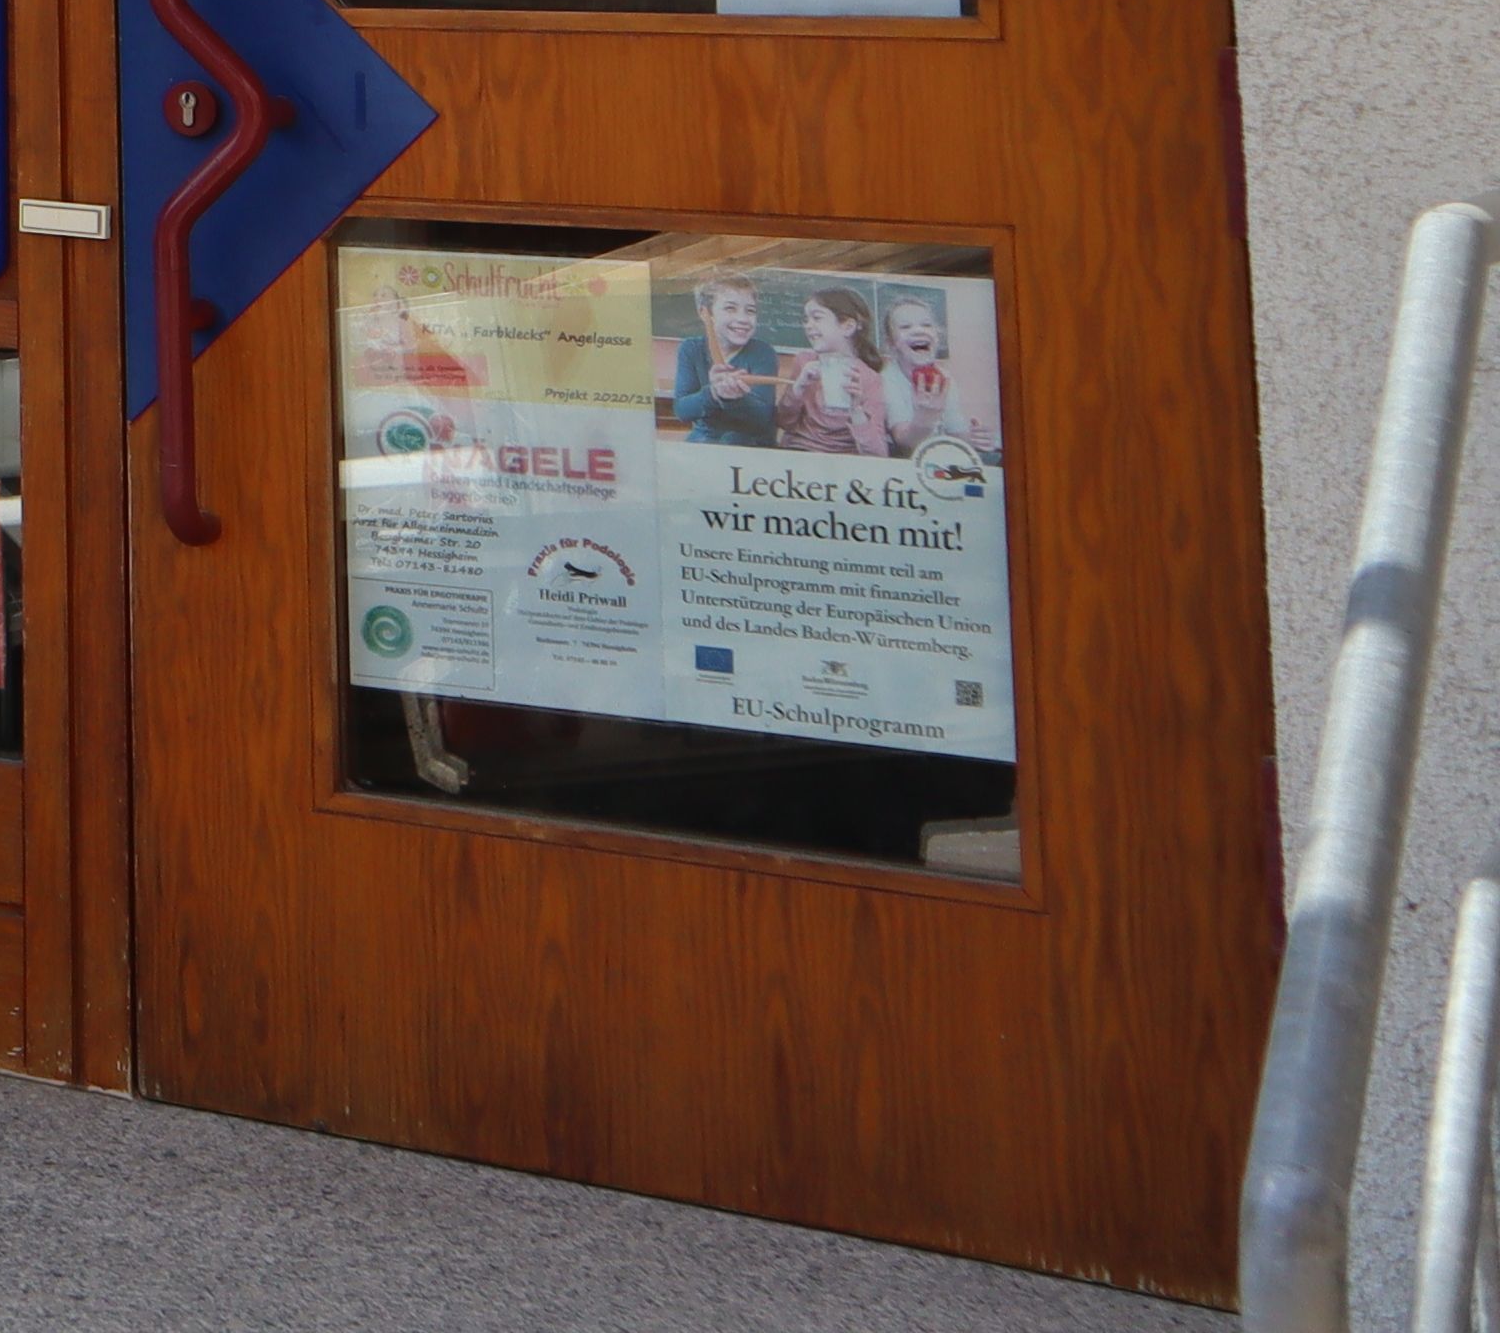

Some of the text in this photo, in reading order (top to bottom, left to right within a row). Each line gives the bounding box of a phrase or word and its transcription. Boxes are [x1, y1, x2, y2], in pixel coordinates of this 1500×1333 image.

[443, 261, 561, 300] Schulfrucht
[422, 323, 632, 348] KITA Angelgasse
[545, 388, 588, 402] Projekt
[506, 477, 616, 500] Landschaftspflege
[729, 466, 928, 516] Lecker & fit,
[352, 518, 499, 538] Arzt für Allgemeinmedizin
[358, 504, 373, 515] Dr.
[409, 508, 438, 521] Peter
[443, 511, 493, 524] Sartorius
[702, 503, 963, 551] wir machen mit!
[418, 548, 478, 563] Hessigheim
[440, 536, 481, 550] Str. 20
[528, 538, 636, 586] Praxis für Podologie
[680, 542, 943, 581] Unsere Einrichtung nimmt teil am
[384, 586, 412, 595] PRAXIS
[413, 589, 429, 597] FÜR
[539, 588, 627, 608] Heidi Priwall
[682, 566, 961, 607] EU-Schulprogramm mit finanzieller
[682, 589, 991, 634] Unterstützung der Europäischen Union
[682, 614, 973, 660] und des Landes Baden-Württemberg.
[732, 696, 945, 739] EU-Schulprogramm
